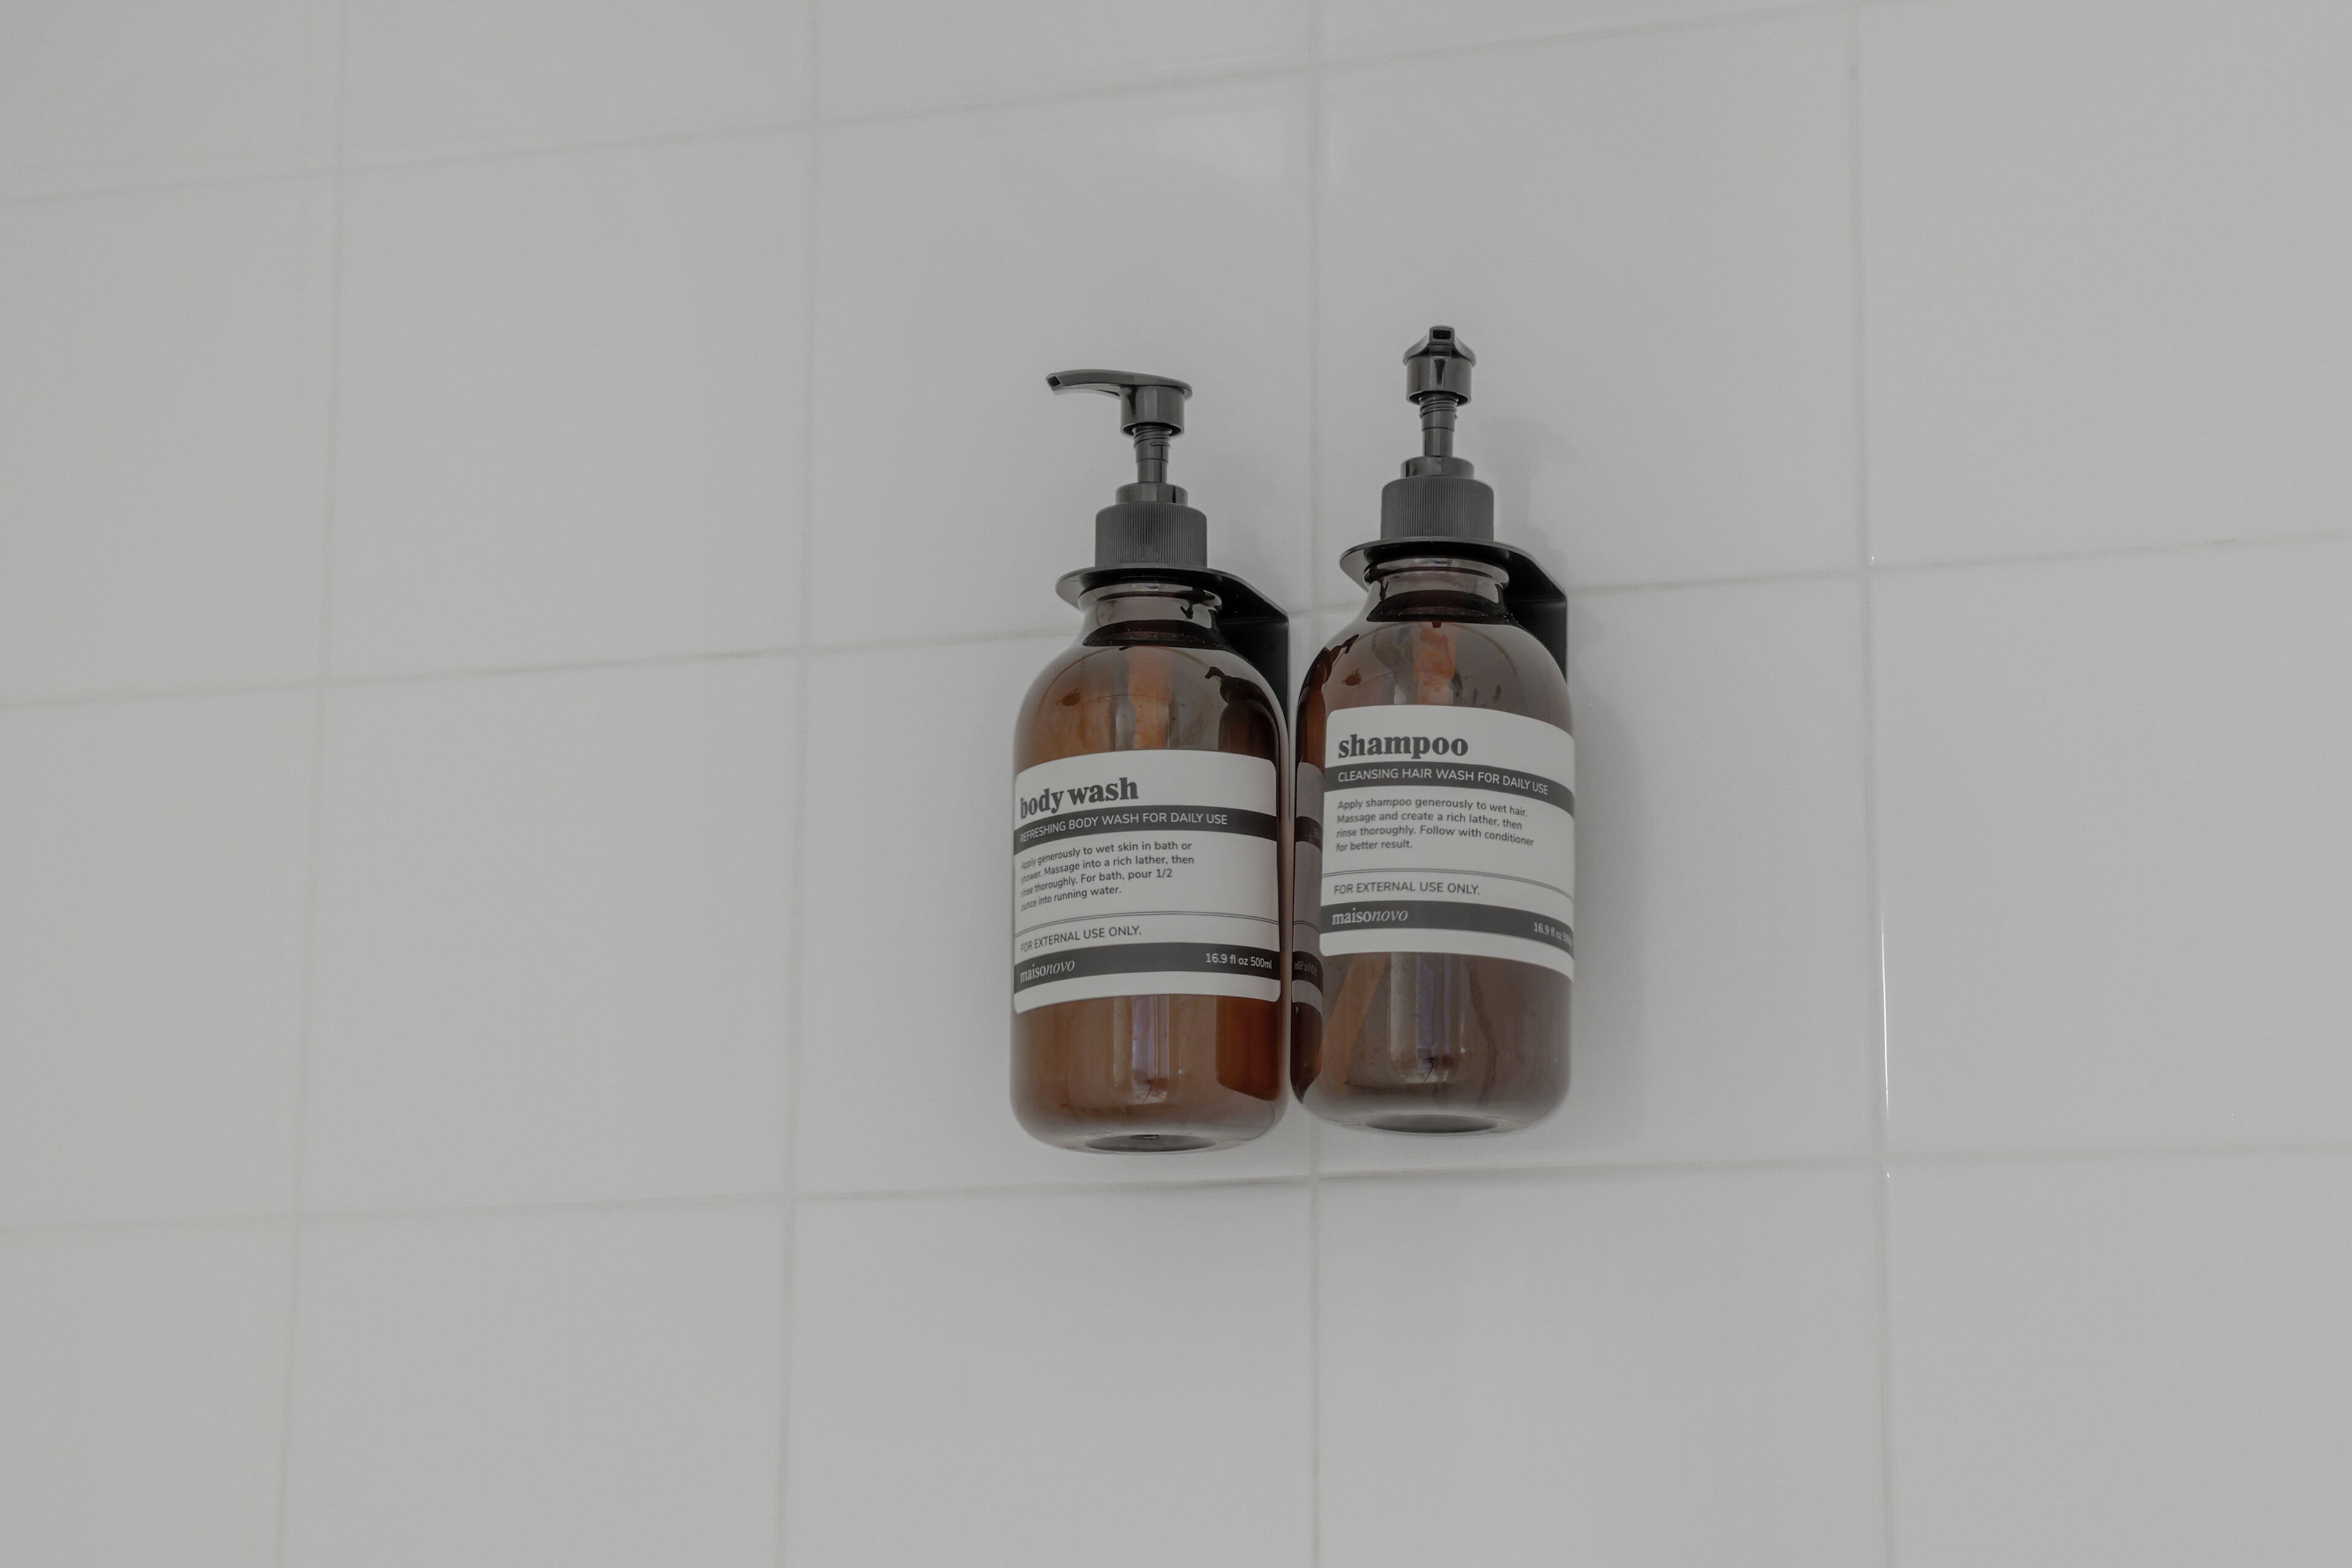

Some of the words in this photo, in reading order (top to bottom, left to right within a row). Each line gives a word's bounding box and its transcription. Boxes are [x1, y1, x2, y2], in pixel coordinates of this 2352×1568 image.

[1338, 734, 1468, 759] shampoo
[1338, 768, 1399, 782] CLEANSING
[1402, 768, 1432, 779] HAIR
[1436, 769, 1474, 781] WASH
[1477, 772, 1500, 784] FOR
[1502, 775, 1531, 790] DAILY
[1532, 782, 1548, 795] USE
[1020, 788, 1064, 820] body
[1067, 777, 1139, 805] wash
[1338, 799, 1363, 810] Apply
[1366, 798, 1412, 808] shampoo
[1415, 799, 1473, 810] generously
[1476, 801, 1487, 810] to
[1490, 804, 1507, 813] wet
[1510, 805, 1528, 817] hair.
[1020, 821, 1066, 843] REFRESHING
[1069, 816, 1099, 830] BODY
[1101, 813, 1139, 824] WASH
[1142, 812, 1167, 823] FOR
[1170, 813, 1204, 823] DAILY
[1207, 813, 1227, 825] USE
[1337, 813, 1376, 823] Massage
[1379, 811, 1398, 820] and
[1447, 812, 1466, 822] rich
[1469, 814, 1499, 827] lather,
[1502, 819, 1522, 830] then
[1336, 829, 1357, 838] rinse
[1360, 825, 1416, 836] thoroughly.
[1420, 825, 1455, 835] Follow
[1458, 828, 1481, 837] with
[1485, 831, 1534, 846] conditioner
[1336, 842, 1348, 852] for
[1350, 842, 1378, 850] better
[1381, 839, 1412, 848] result.
[1038, 848, 1080, 865] generously
[1096, 844, 1115, 853] wet
[1118, 842, 1139, 851] skin
[1142, 842, 1151, 850] in
[1155, 841, 1178, 850] bath
[1020, 870, 1042, 884] shower.
[1044, 862, 1080, 876] Massage
[1082, 859, 1101, 869] into
[1113, 856, 1132, 865] rich
[1136, 855, 1168, 864] lather,
[1172, 855, 1194, 864] then
[1035, 876, 1077, 892] thoroughly.
[1081, 874, 1096, 883] For
[1099, 871, 1125, 881] bath,
[1128, 871, 1152, 880] pour
[1156, 869, 1172, 878] 1/2
[1038, 896, 1052, 906] into
[1054, 890, 1087, 902] running
[1090, 886, 1121, 896] water.
[1334, 884, 1354, 895] FOR
[1357, 882, 1416, 893] EXTERNAL
[1420, 882, 1443, 892] USE
[1447, 883, 1480, 895] ONLY.
[1332, 907, 1408, 925] maisonovo
[1020, 941, 1033, 953] FOR
[1035, 931, 1080, 949] EXTERNAL
[1084, 927, 1105, 939] USE
[1109, 925, 1141, 937] ONLY.
[1533, 921, 1550, 936] 16.9
[1020, 960, 1075, 983] maisonovo
[1205, 953, 1227, 963] 16.9
[1230, 954, 1236, 965] fl
[1238, 957, 1248, 967] oz
[1251, 957, 1272, 970] 500ml
